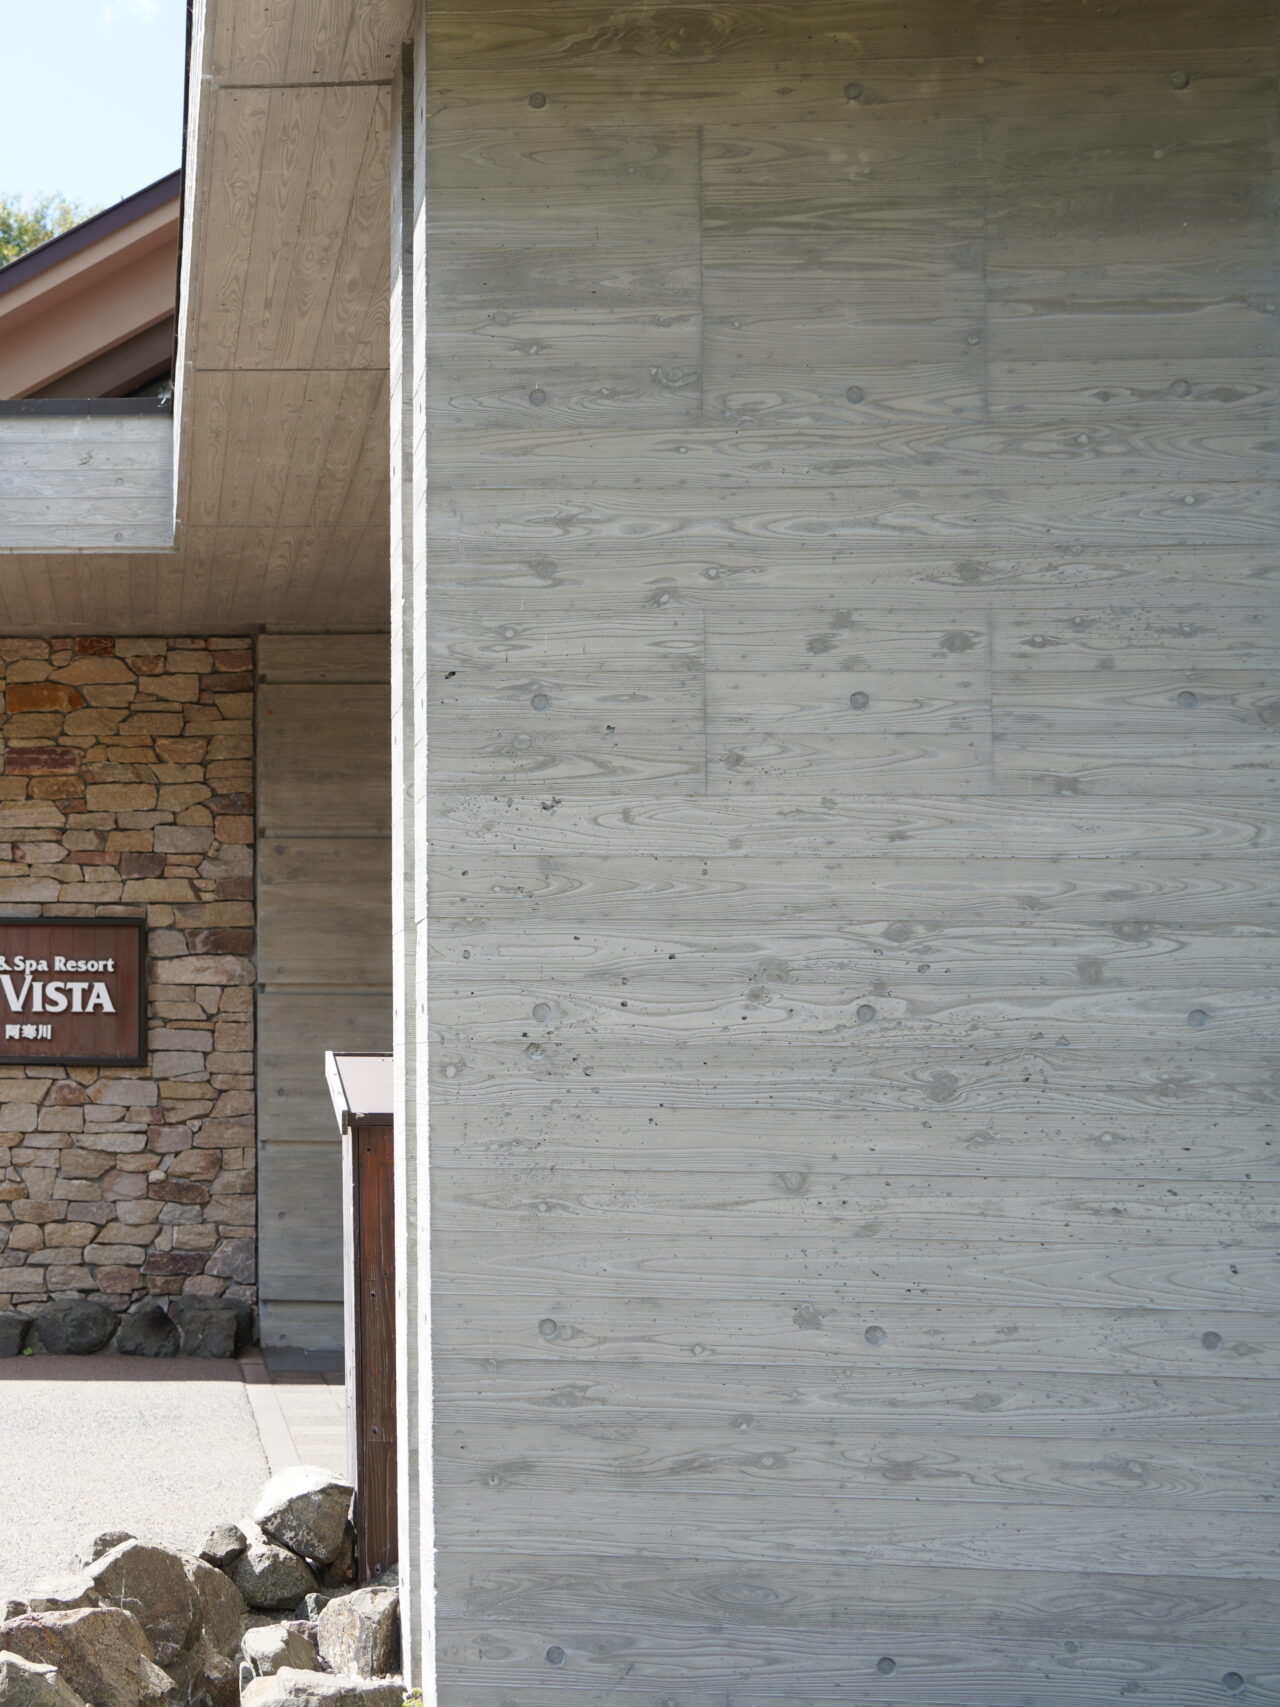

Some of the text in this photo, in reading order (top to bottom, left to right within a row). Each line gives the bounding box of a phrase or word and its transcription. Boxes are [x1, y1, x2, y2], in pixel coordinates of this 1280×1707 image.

[14, 956, 48, 975] Spa
[54, 956, 115, 972] Resort
[0, 974, 116, 1013] VISTA
[5, 1024, 52, 1040] 阿寒川
